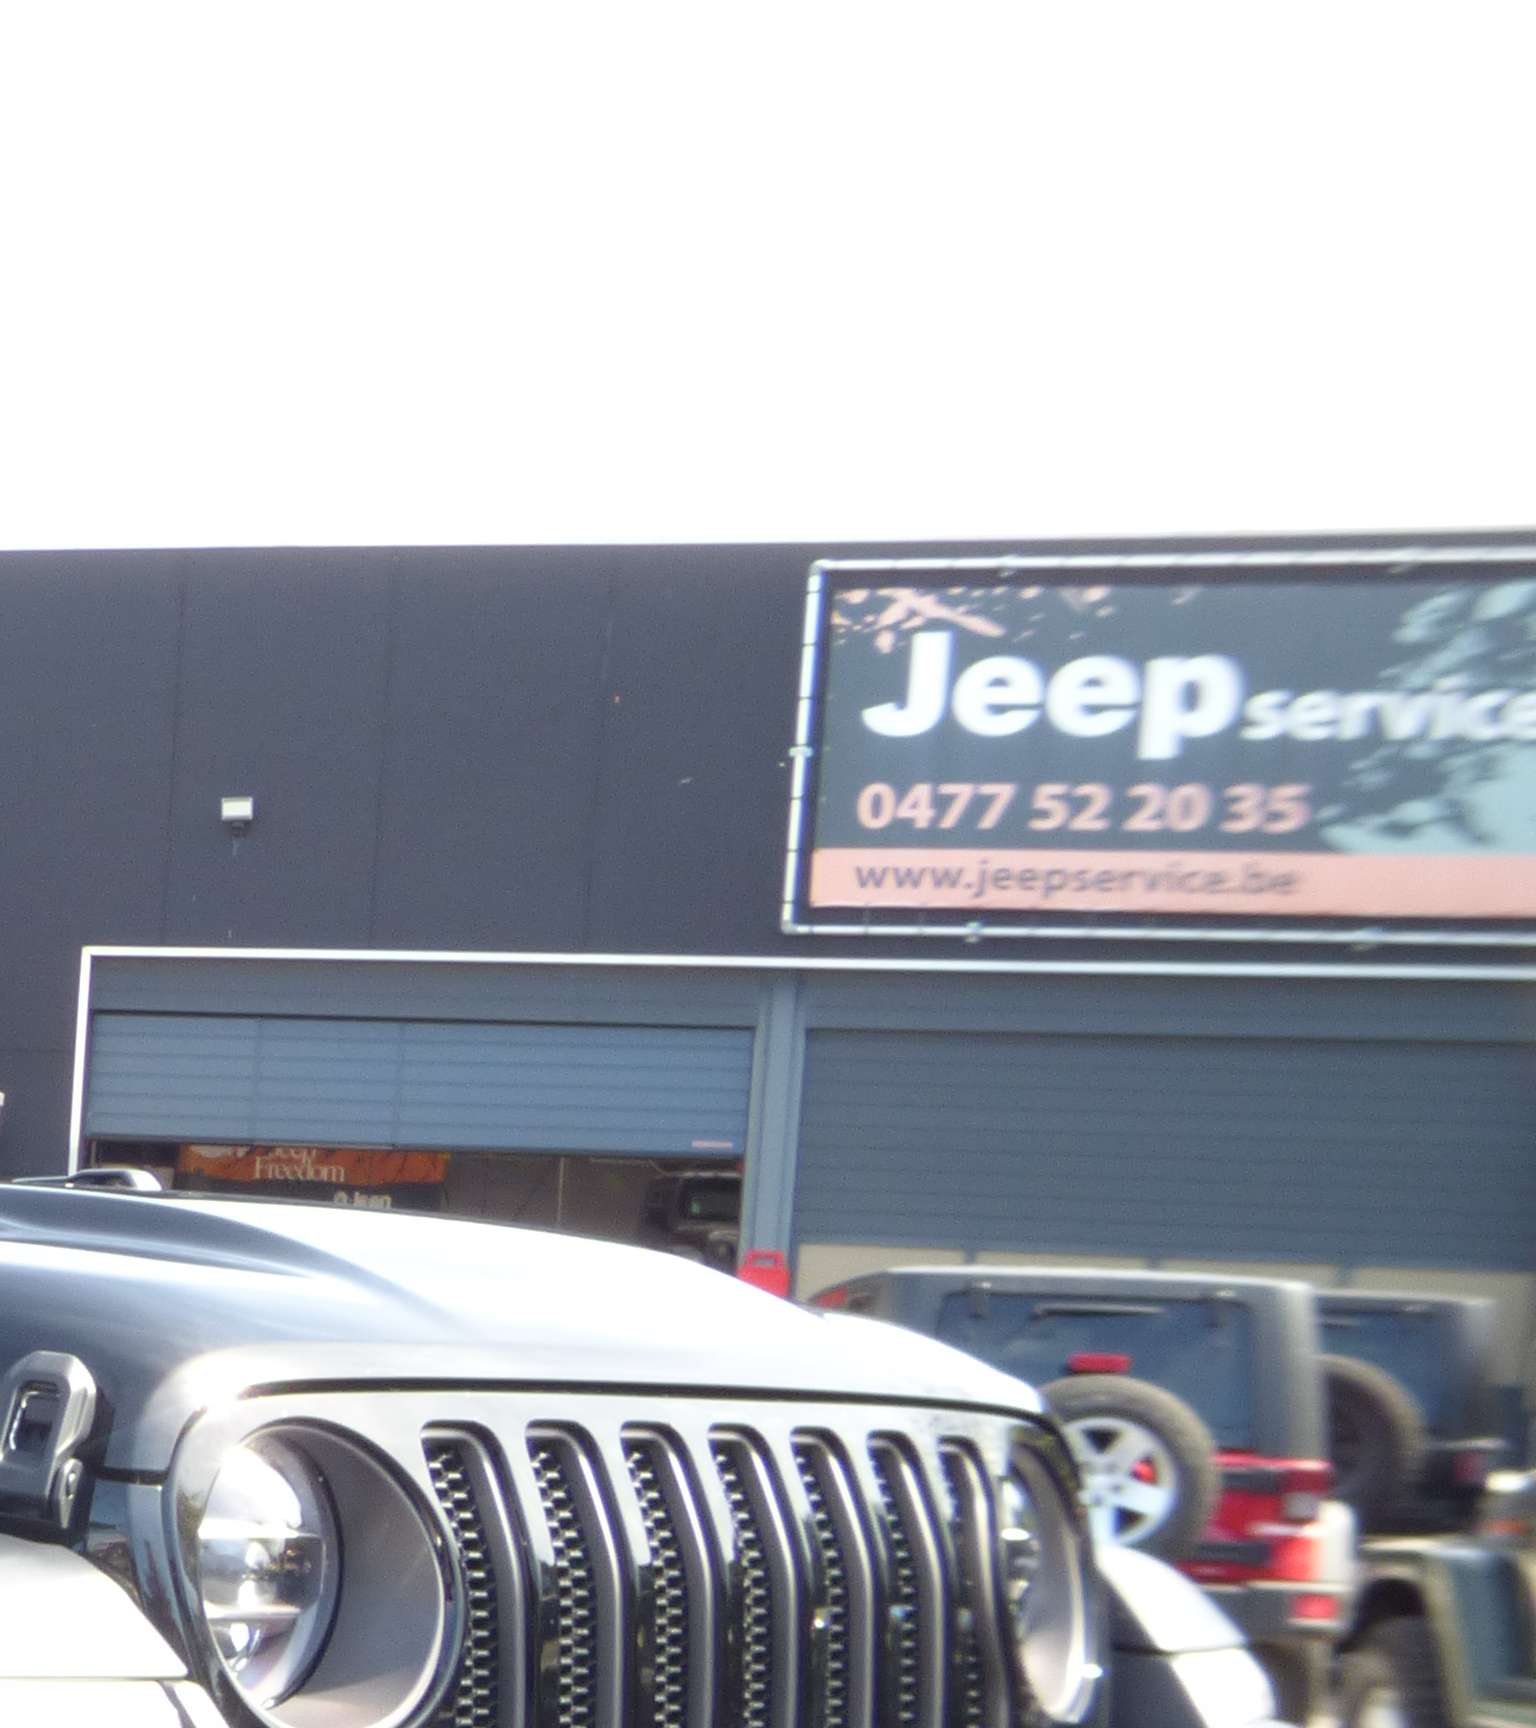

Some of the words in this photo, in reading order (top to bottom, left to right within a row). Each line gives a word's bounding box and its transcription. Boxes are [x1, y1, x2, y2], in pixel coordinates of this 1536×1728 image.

[862, 631, 1244, 760] Jeep
[1241, 673, 1536, 741] service
[856, 782, 1015, 830] 0477
[1027, 783, 1111, 831] 52
[1122, 783, 1213, 832] 20
[1219, 783, 1313, 834] 35
[854, 858, 1301, 899] www.jeepservice.be
[254, 1156, 345, 1182] Freedom
